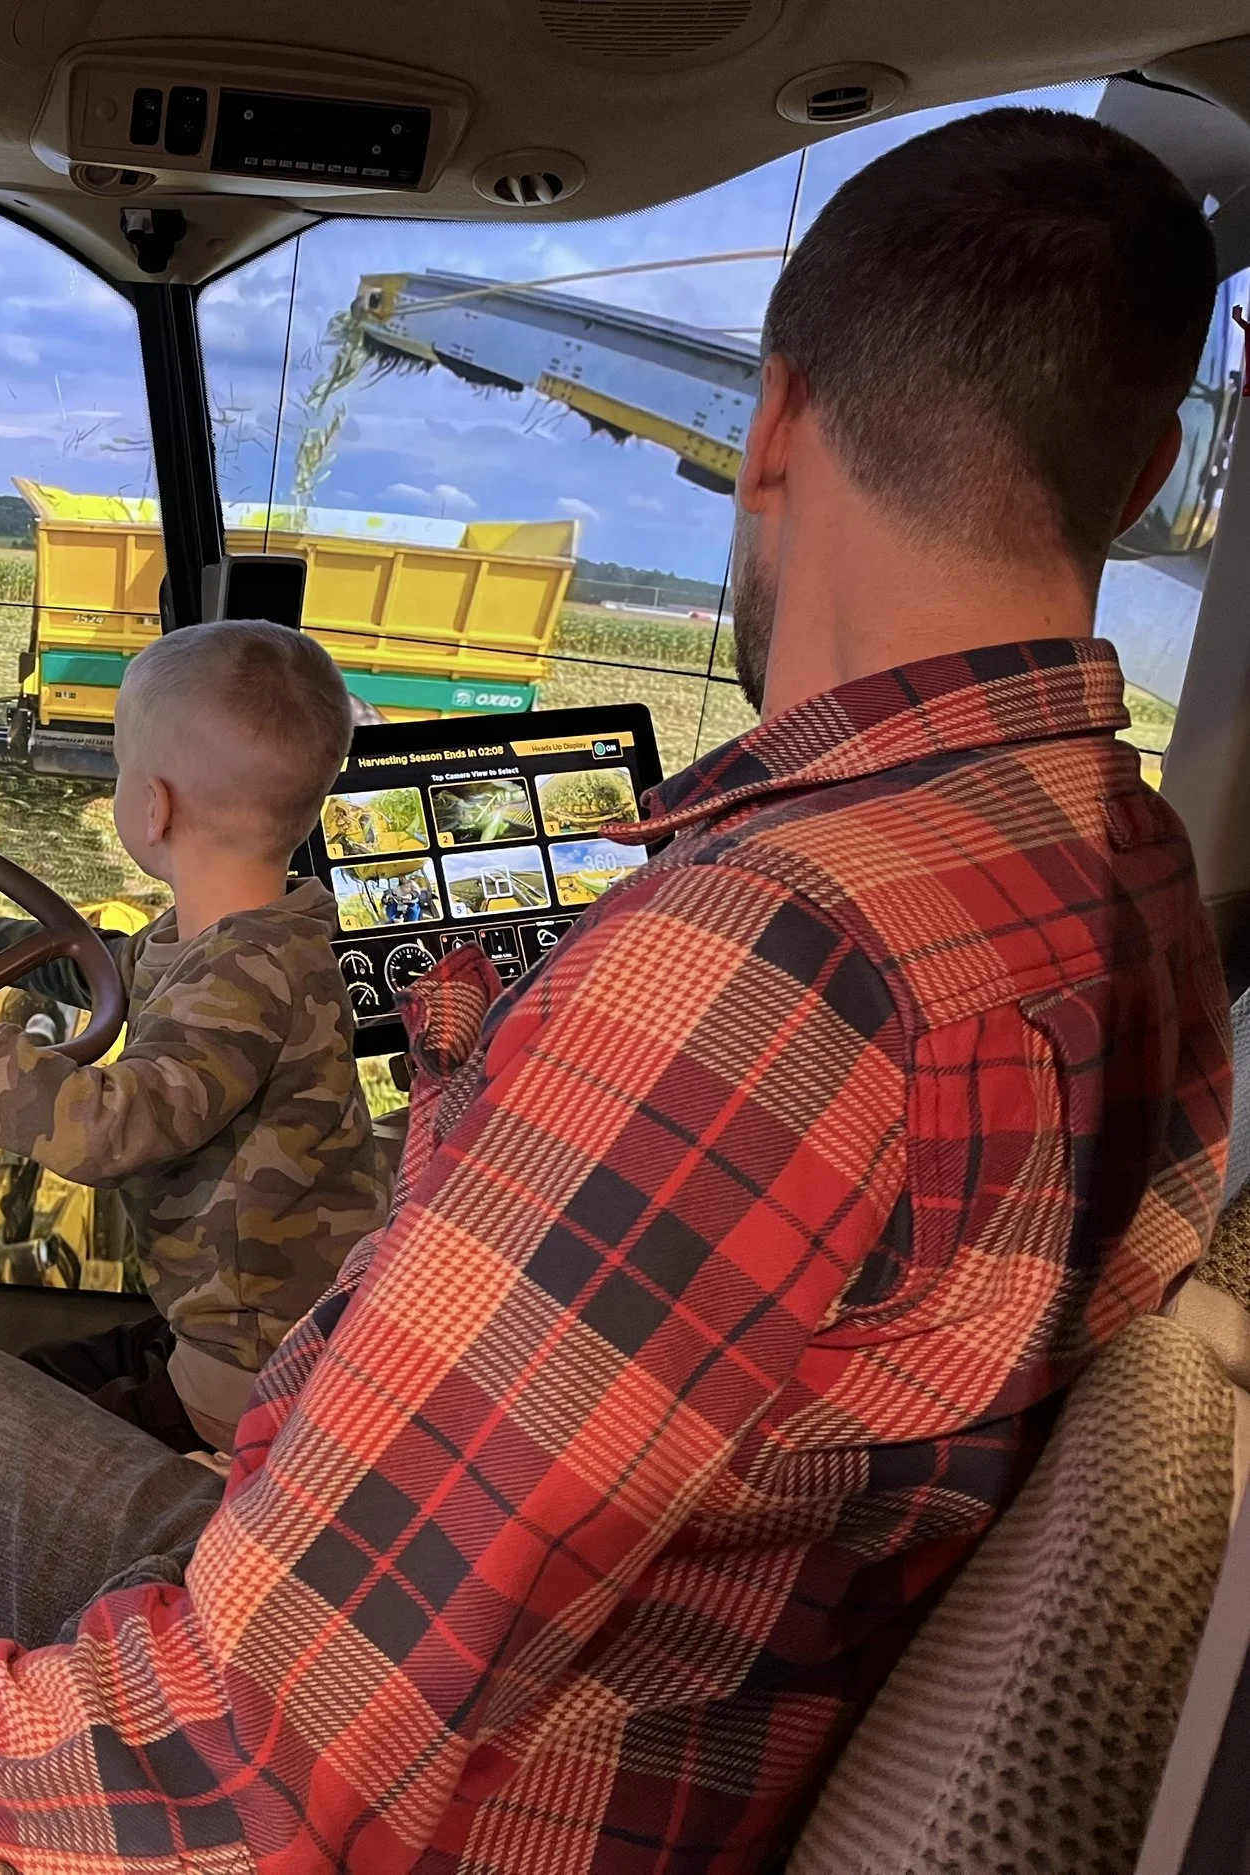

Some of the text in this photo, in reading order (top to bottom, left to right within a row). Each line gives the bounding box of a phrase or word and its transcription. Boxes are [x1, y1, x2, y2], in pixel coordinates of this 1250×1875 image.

[475, 693, 523, 708] OXBO
[531, 742, 587, 753] Heads Up Display
[358, 755, 408, 768] Harvesting
[409, 752, 442, 763] Season
[444, 749, 466, 760] Ends
[445, 772, 470, 780] Camera
[471, 770, 488, 778] View
[498, 766, 519, 775] Select
